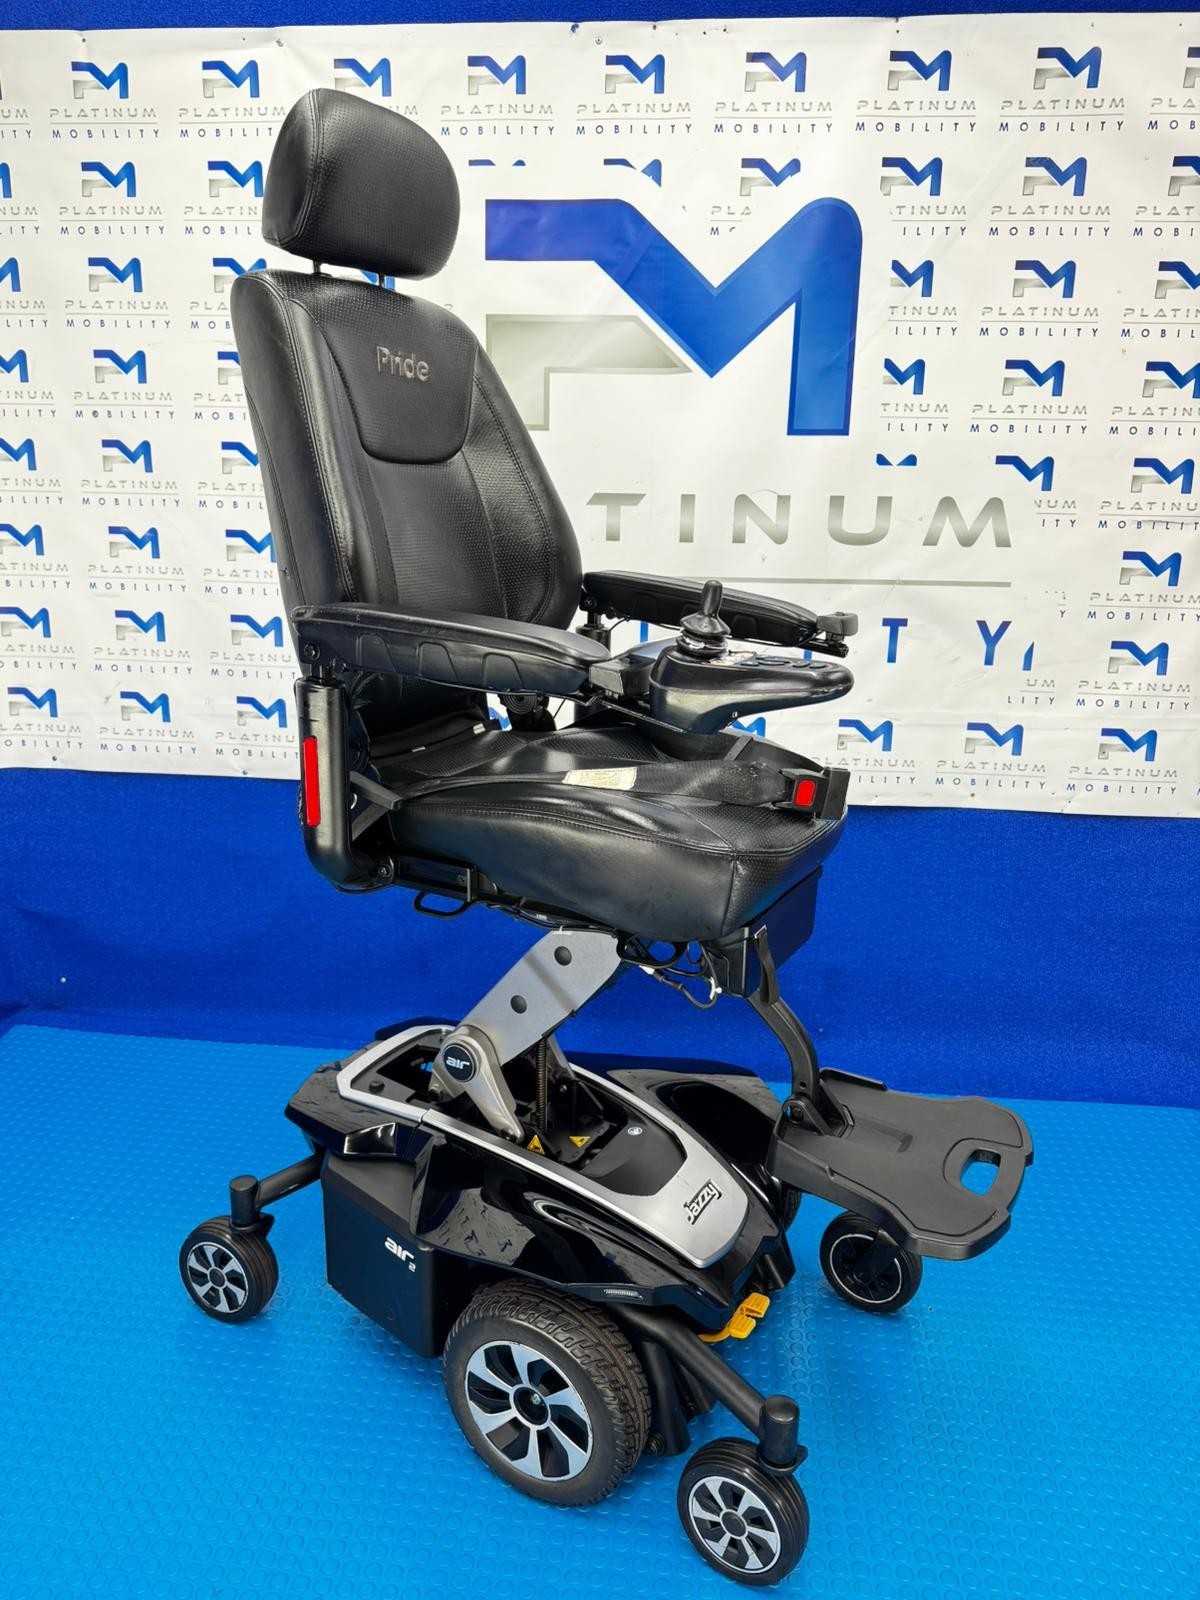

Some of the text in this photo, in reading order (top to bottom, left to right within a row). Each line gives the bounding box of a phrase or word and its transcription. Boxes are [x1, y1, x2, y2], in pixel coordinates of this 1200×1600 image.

[440, 103, 553, 115] PLATINUM
[576, 101, 691, 115] PLATINUM
[714, 101, 832, 113] PLATINUM
[856, 99, 977, 111] PLATINUM
[1000, 97, 1125, 111] PLATINUM
[49, 107, 157, 118] PLATINUM
[178, 106, 286, 118] PLATINUM
[440, 125, 555, 136] MOBILITY
[575, 123, 692, 136] MOBILITY
[713, 122, 833, 134] MOBILITY
[855, 121, 977, 133] MOBILITY
[998, 120, 1124, 132] MOBILITY
[52, 128, 160, 139] MOBILITY
[59, 205, 162, 216] PLATINUM
[990, 205, 1111, 216] PLATINUM
[60, 225, 165, 236] MOBILITY
[988, 226, 1111, 237] MOBILITY
[64, 299, 168, 310] PLATINUM
[981, 306, 1099, 317] PLATINUM
[66, 318, 171, 329] MOBILITY
[979, 326, 1099, 338] MOBILITY
[376, 345, 431, 382] Pride
[73, 391, 174, 401] PLATINUM
[971, 404, 1088, 415] PLATINUM
[969, 423, 1088, 435] MOBILITY
[81, 480, 178, 490] PLATINUM
[81, 497, 180, 508] MOBILITY
[87, 564, 183, 576] PLATINUM
[89, 581, 186, 592] MOBILITY
[94, 646, 190, 658] PLATINUM
[94, 663, 193, 675] MOBILITY
[1078, 680, 1191, 693] PLATINUM
[1075, 698, 1190, 711] MOBILITY
[99, 726, 193, 738] PLATINUM
[100, 743, 197, 755] MOBILITY
[936, 760, 1046, 773] PLATINUM
[1069, 766, 1178, 778] PLATINUM
[935, 777, 1046, 790] MOBILITY
[1066, 783, 1177, 795] MOBILITY
